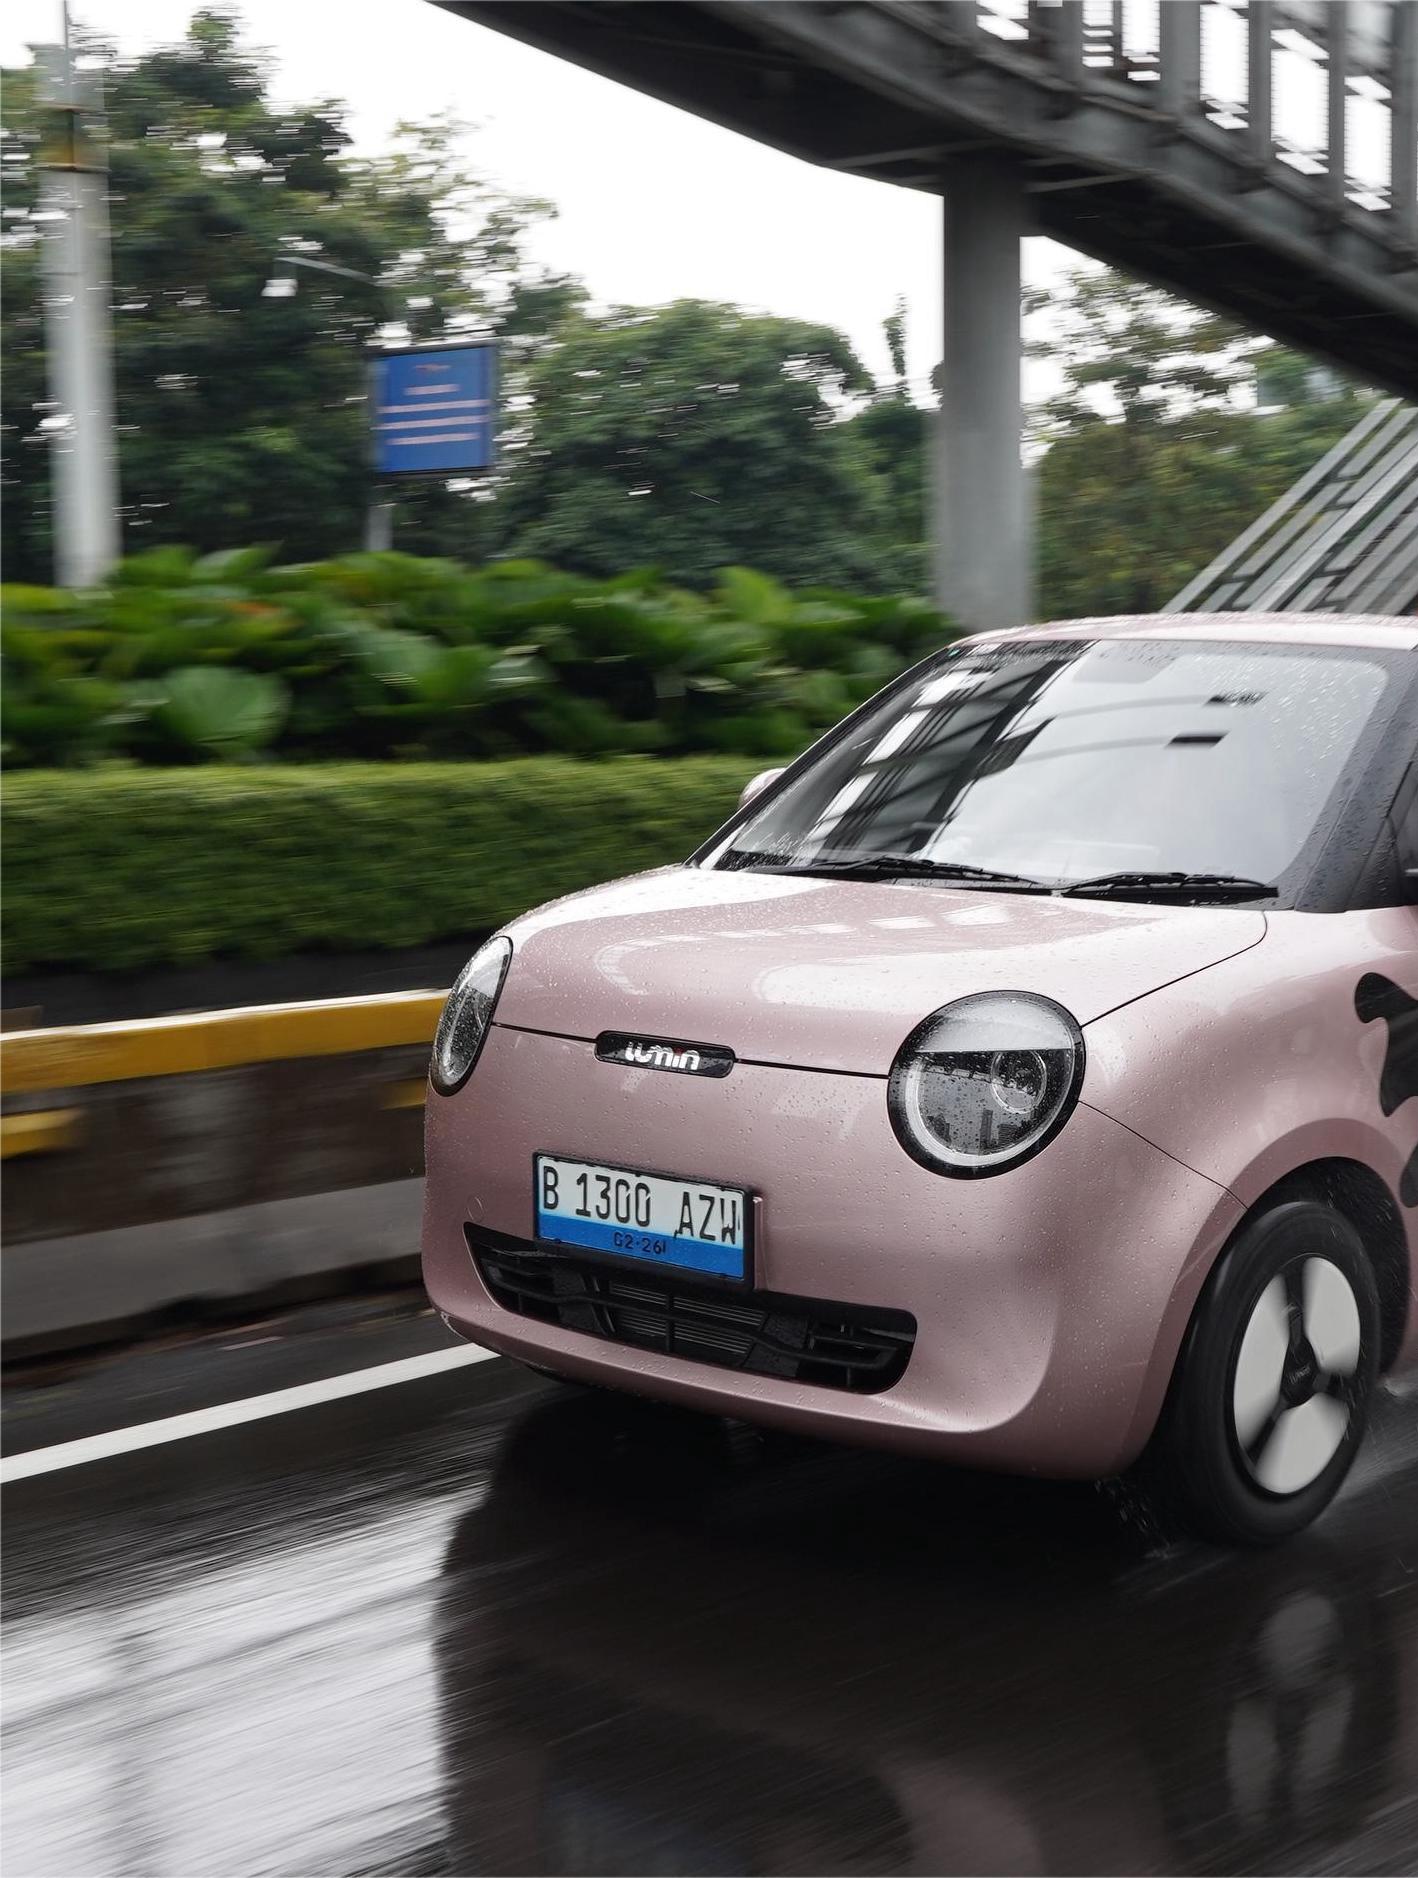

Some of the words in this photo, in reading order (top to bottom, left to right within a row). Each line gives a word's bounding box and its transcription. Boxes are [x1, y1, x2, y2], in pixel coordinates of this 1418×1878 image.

[542, 1165, 559, 1211] B
[575, 1172, 651, 1228] 1300
[677, 1190, 737, 1246] AZW
